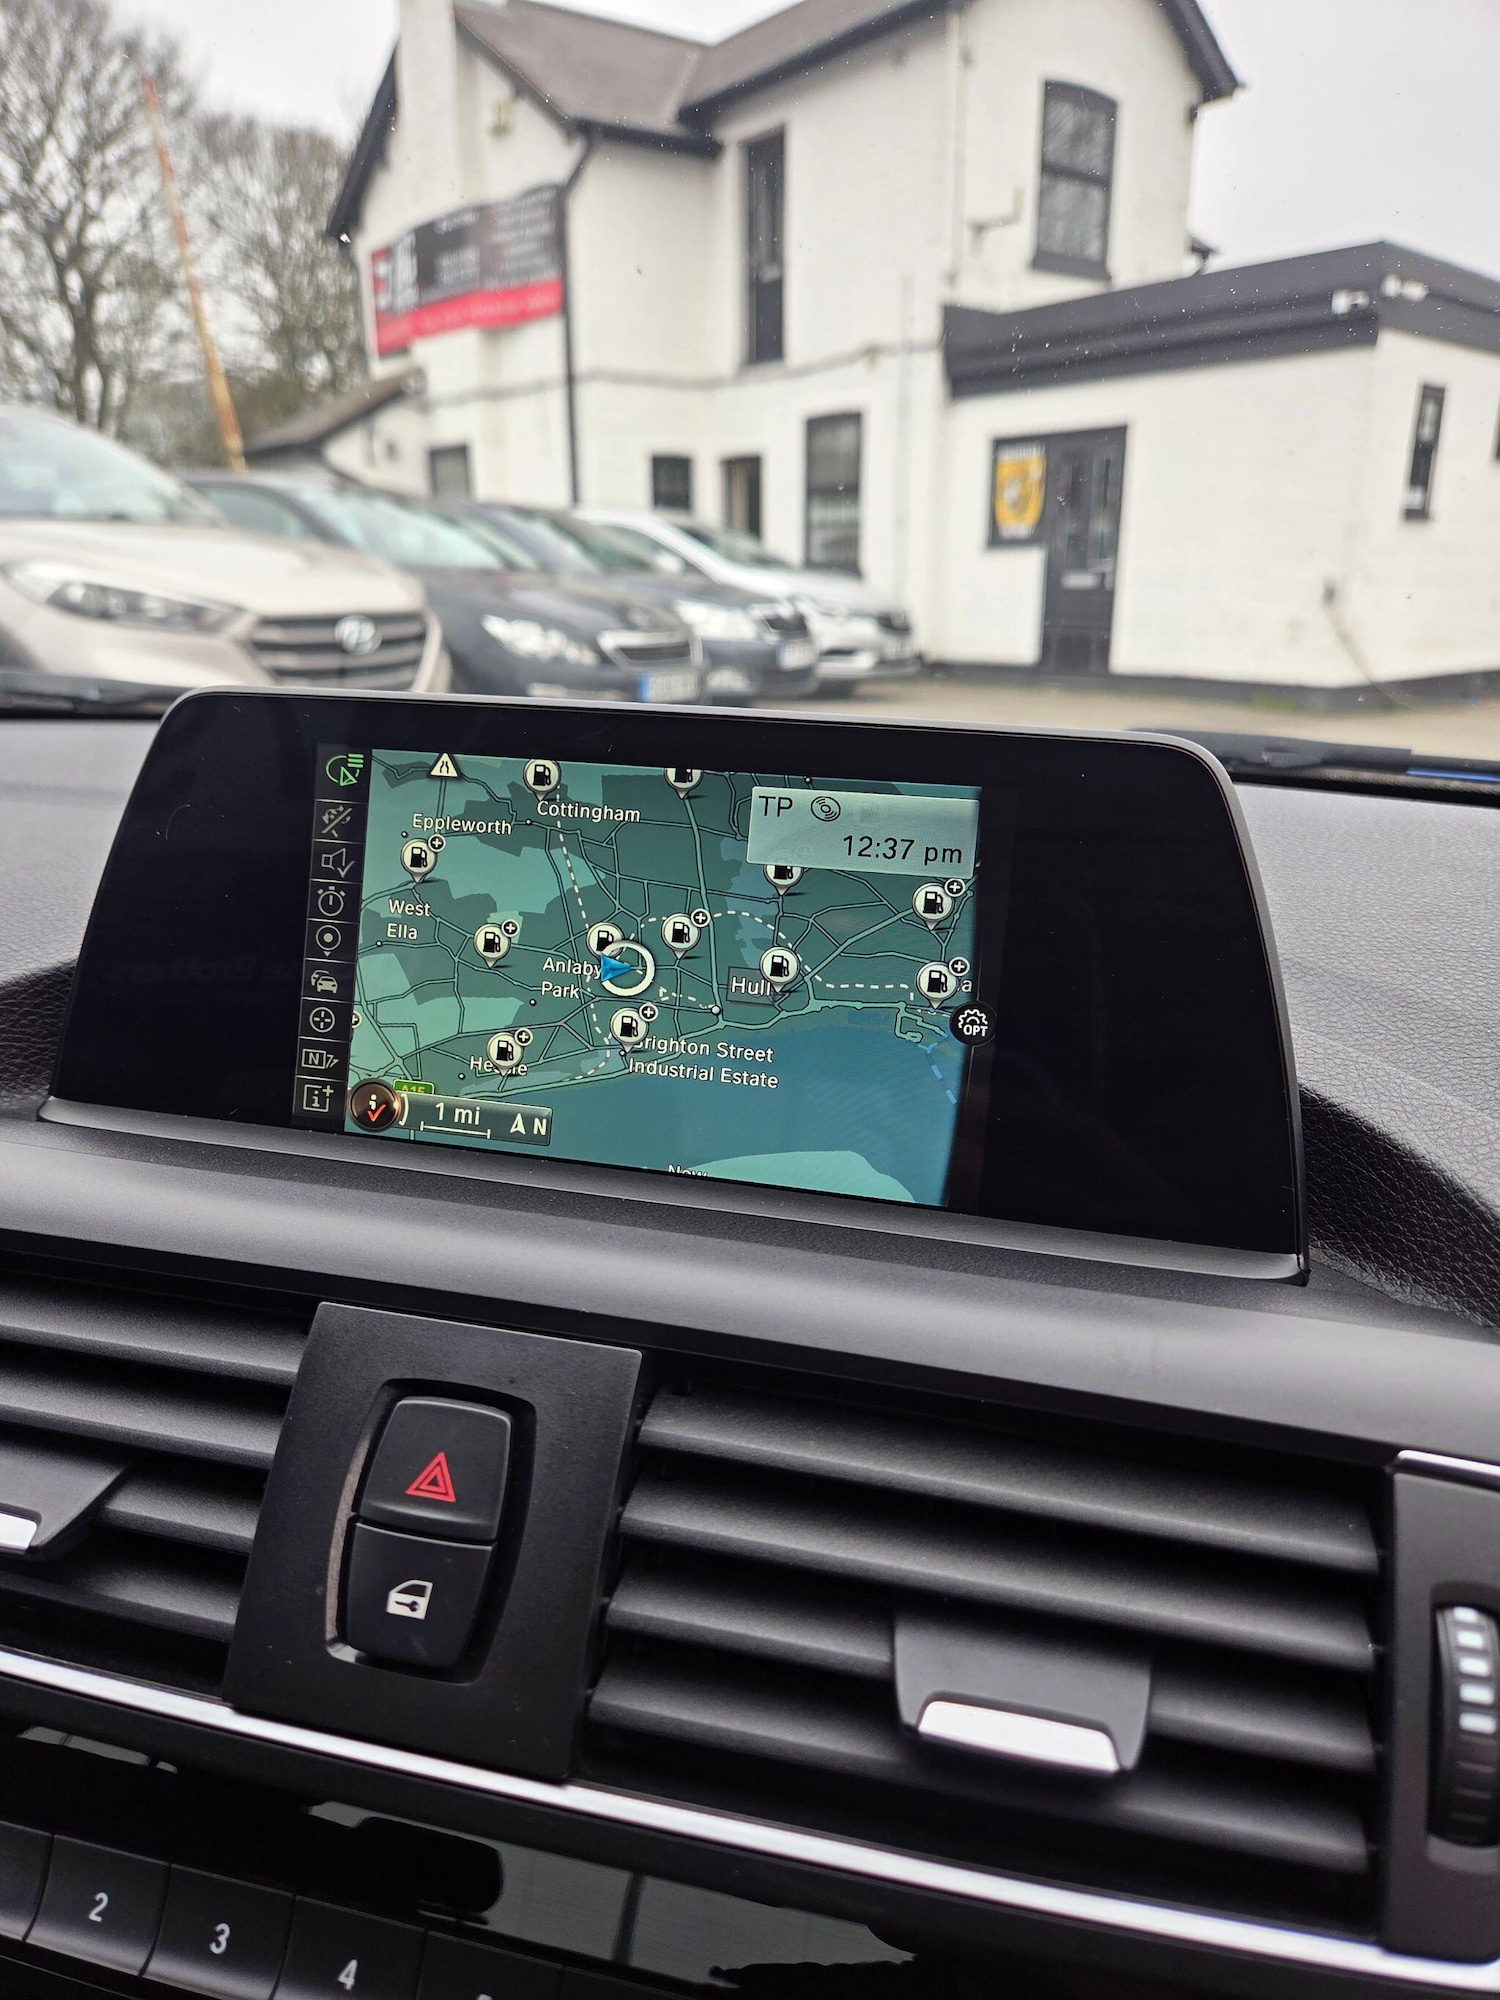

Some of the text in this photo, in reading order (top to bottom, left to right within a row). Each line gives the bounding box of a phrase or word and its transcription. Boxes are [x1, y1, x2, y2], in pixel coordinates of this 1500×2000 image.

[537, 800, 641, 823] Cottingham
[758, 795, 793, 818] TP
[412, 813, 512, 835] Eppleworth
[843, 835, 962, 866] 12:37 pm
[388, 899, 431, 917] West
[386, 923, 418, 940] Ella
[542, 956, 602, 980] Anlaby
[541, 981, 580, 999] Park
[731, 976, 771, 997] Hull
[963, 1024, 989, 1037] OPT
[634, 1035, 774, 1063] righton Street
[470, 1055, 529, 1076] Hee
[629, 1058, 779, 1089] Industrial Estate
[435, 1102, 481, 1125] 1 mi
[533, 1117, 547, 1136] N
[88, 1891, 109, 1922] 2
[209, 1923, 231, 1955] 3
[338, 1959, 358, 1990] 4
